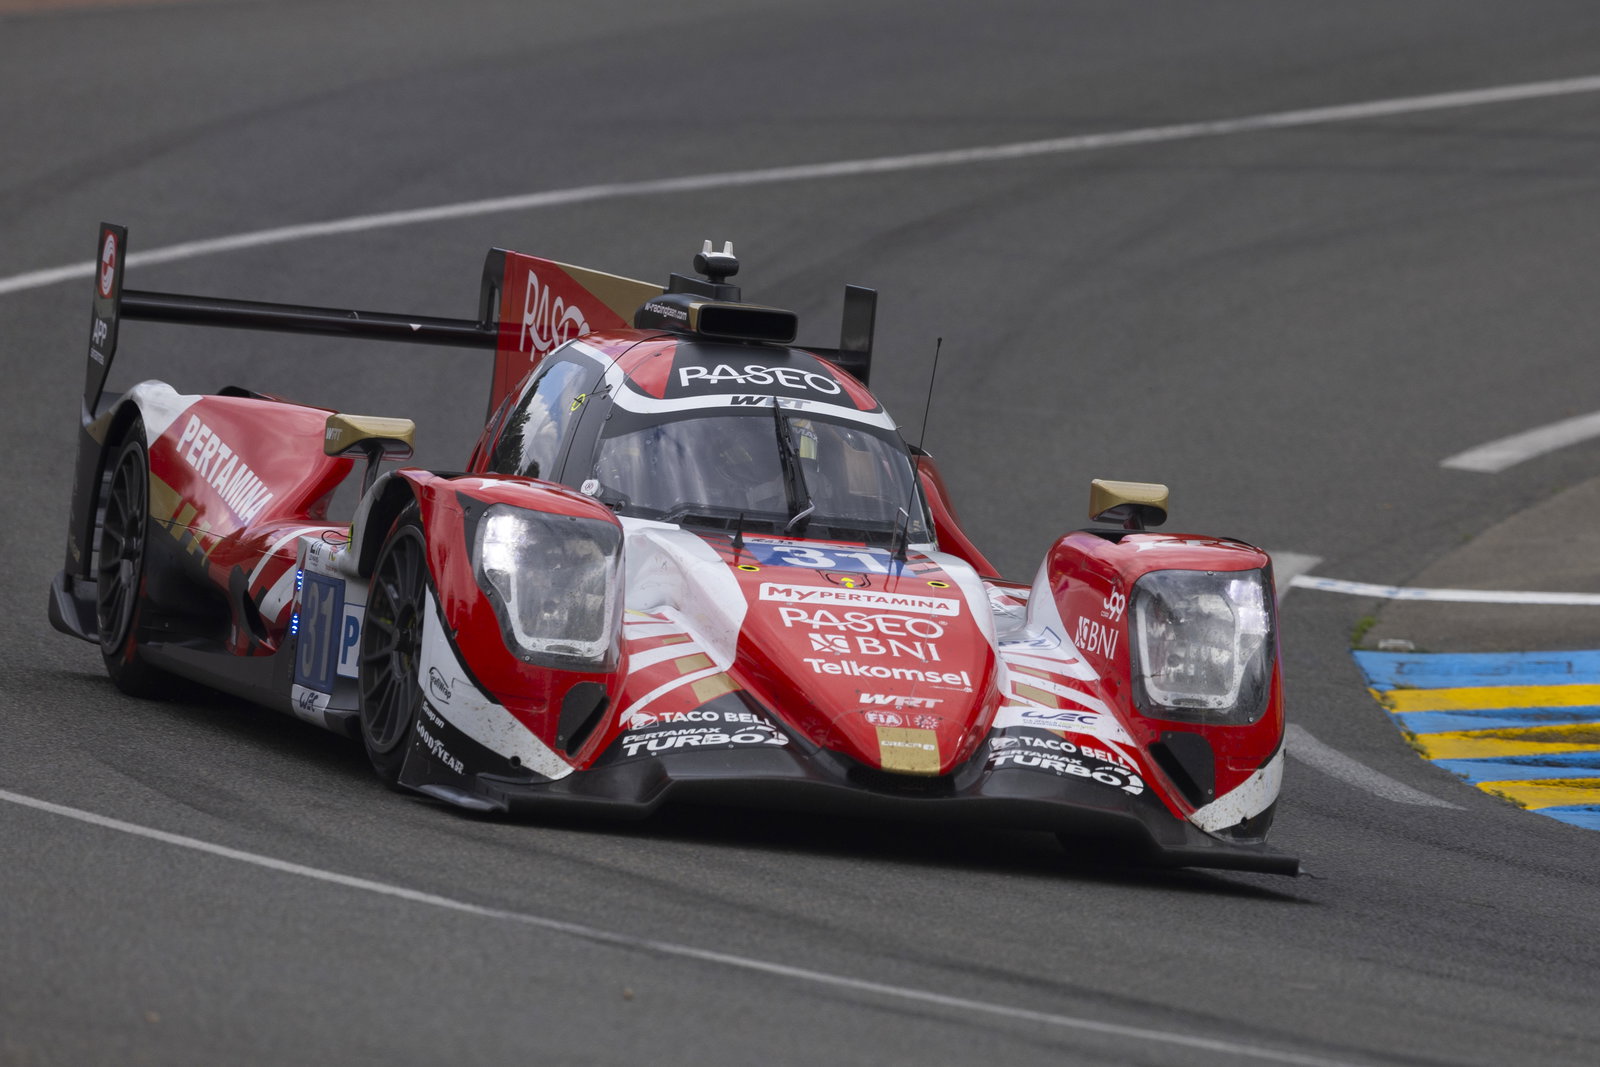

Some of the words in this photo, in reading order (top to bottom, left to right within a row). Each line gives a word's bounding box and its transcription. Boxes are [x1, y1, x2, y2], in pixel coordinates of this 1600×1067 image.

[175, 414, 274, 526] PERTAMINA
[773, 546, 890, 573] 31
[302, 582, 336, 682] 31
[1087, 621, 1119, 660] BNI
[856, 636, 942, 661] BNI
[803, 658, 972, 687] Telkomsel
[859, 693, 944, 708] WRT
[659, 711, 719, 723] TACO
[723, 712, 777, 730] BELL
[866, 713, 900, 725] FIA
[1021, 711, 1098, 725] WEC
[416, 720, 465, 775] GOODYEAR
[622, 727, 723, 744] PERTAMAX
[623, 733, 766, 757] TURBO
[989, 750, 1082, 767] PERTAMAX
[1019, 736, 1077, 753] TACO
[1080, 745, 1131, 770] BELL
[990, 755, 1122, 786] TURBO
